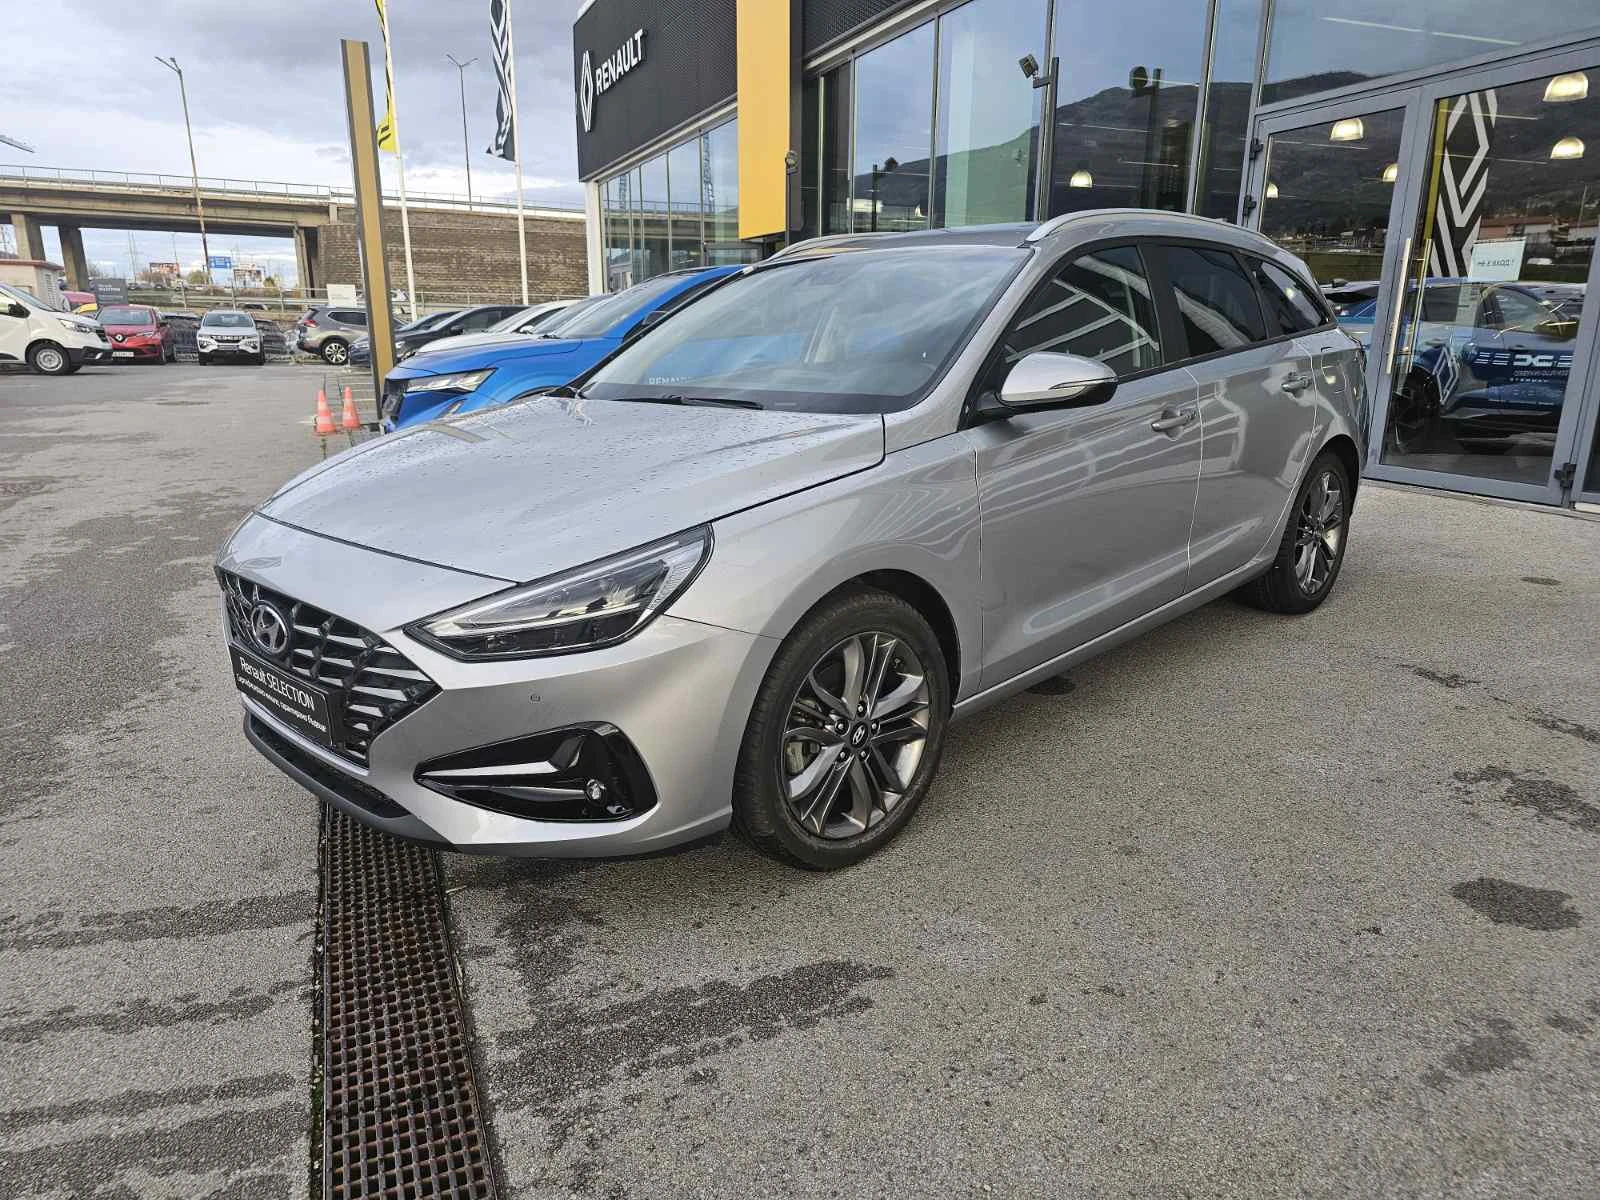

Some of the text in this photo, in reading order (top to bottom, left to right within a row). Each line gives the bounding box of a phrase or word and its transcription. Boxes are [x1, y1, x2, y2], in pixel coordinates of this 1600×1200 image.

[595, 28, 643, 96] RENAULT
[239, 656, 267, 685] Renault
[266, 672, 315, 711] SELECTION
